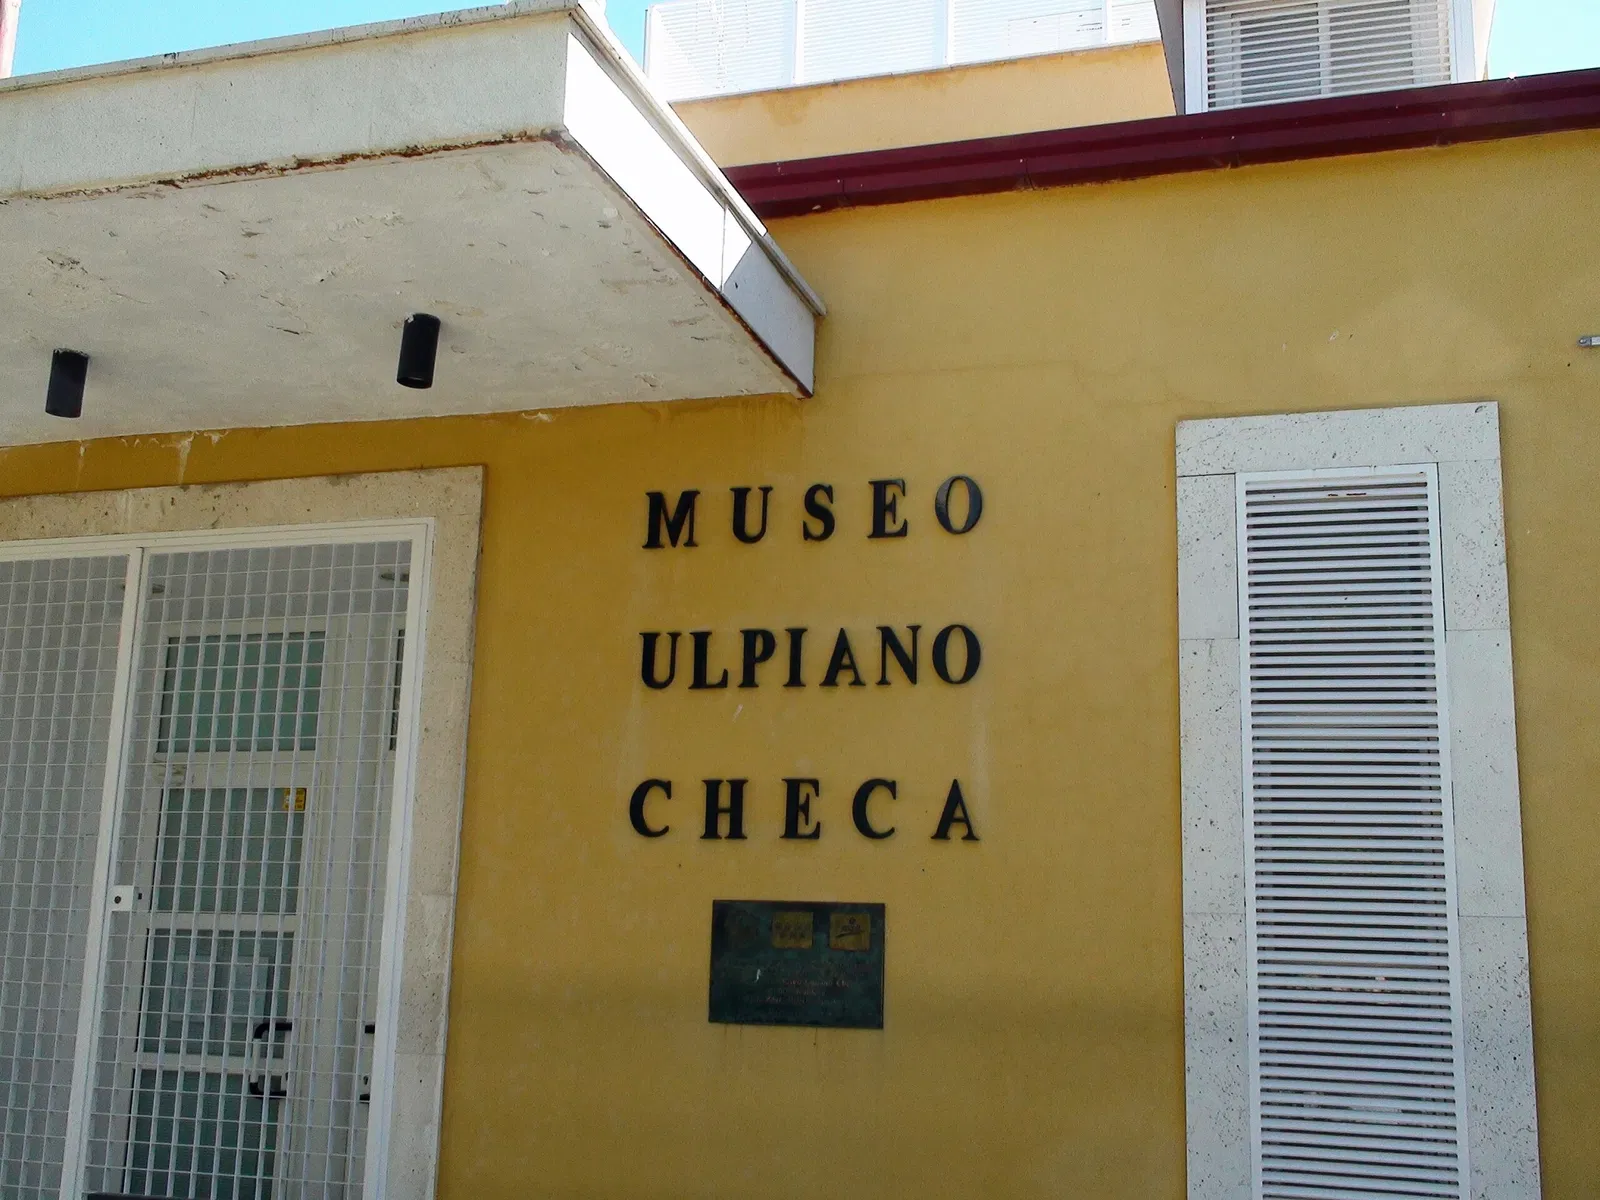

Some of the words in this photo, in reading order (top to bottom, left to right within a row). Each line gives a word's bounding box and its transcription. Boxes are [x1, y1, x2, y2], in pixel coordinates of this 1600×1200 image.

[642, 476, 983, 549] MUSEO
[639, 624, 982, 691] ULPIANO
[628, 778, 980, 842] CHECA
